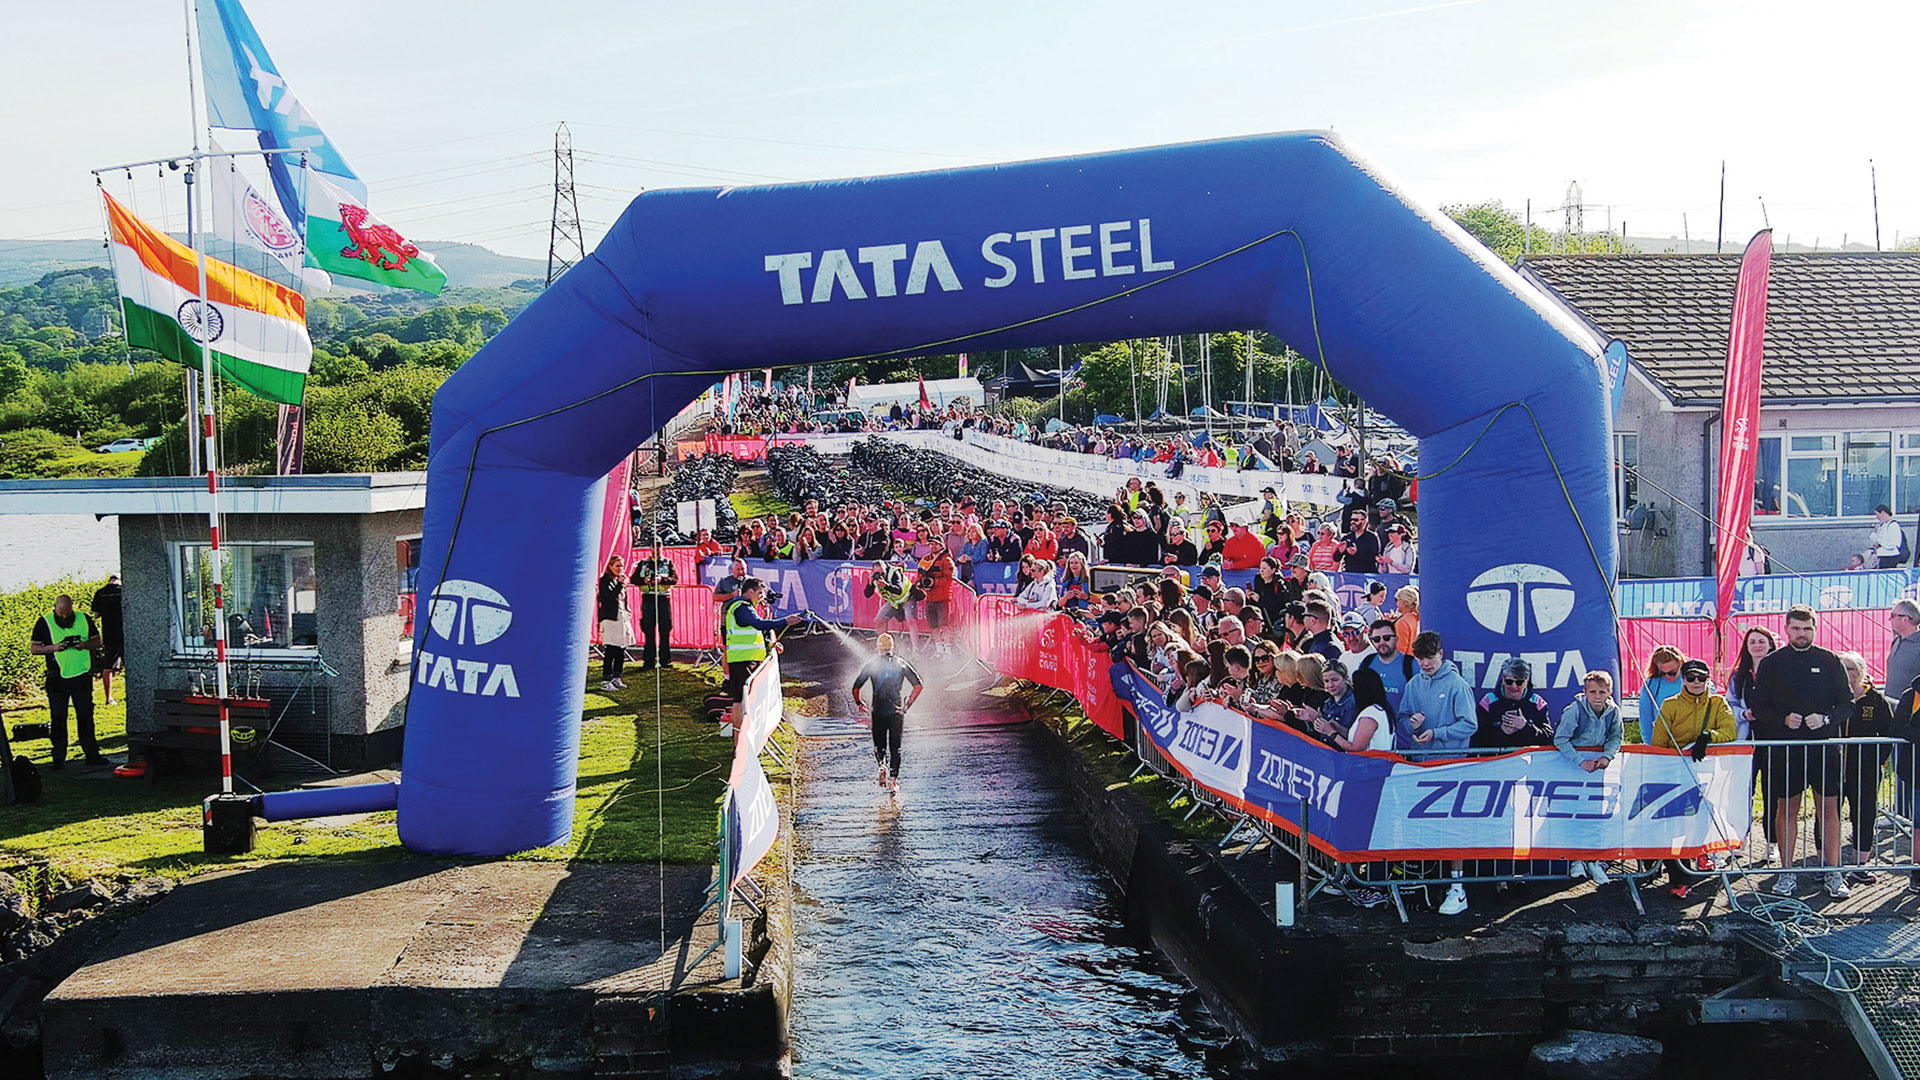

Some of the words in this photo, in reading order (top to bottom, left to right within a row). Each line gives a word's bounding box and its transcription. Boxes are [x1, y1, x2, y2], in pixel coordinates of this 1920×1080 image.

[764, 240, 964, 305] TATA
[981, 218, 1175, 288] STEEL
[1643, 600, 1718, 617] TATA
[417, 648, 521, 697] TATA
[1453, 650, 1587, 689] TATA
[1178, 719, 1220, 761] ZONE3
[1256, 749, 1315, 805] ZONE3
[1407, 779, 1622, 820] ZONE3
